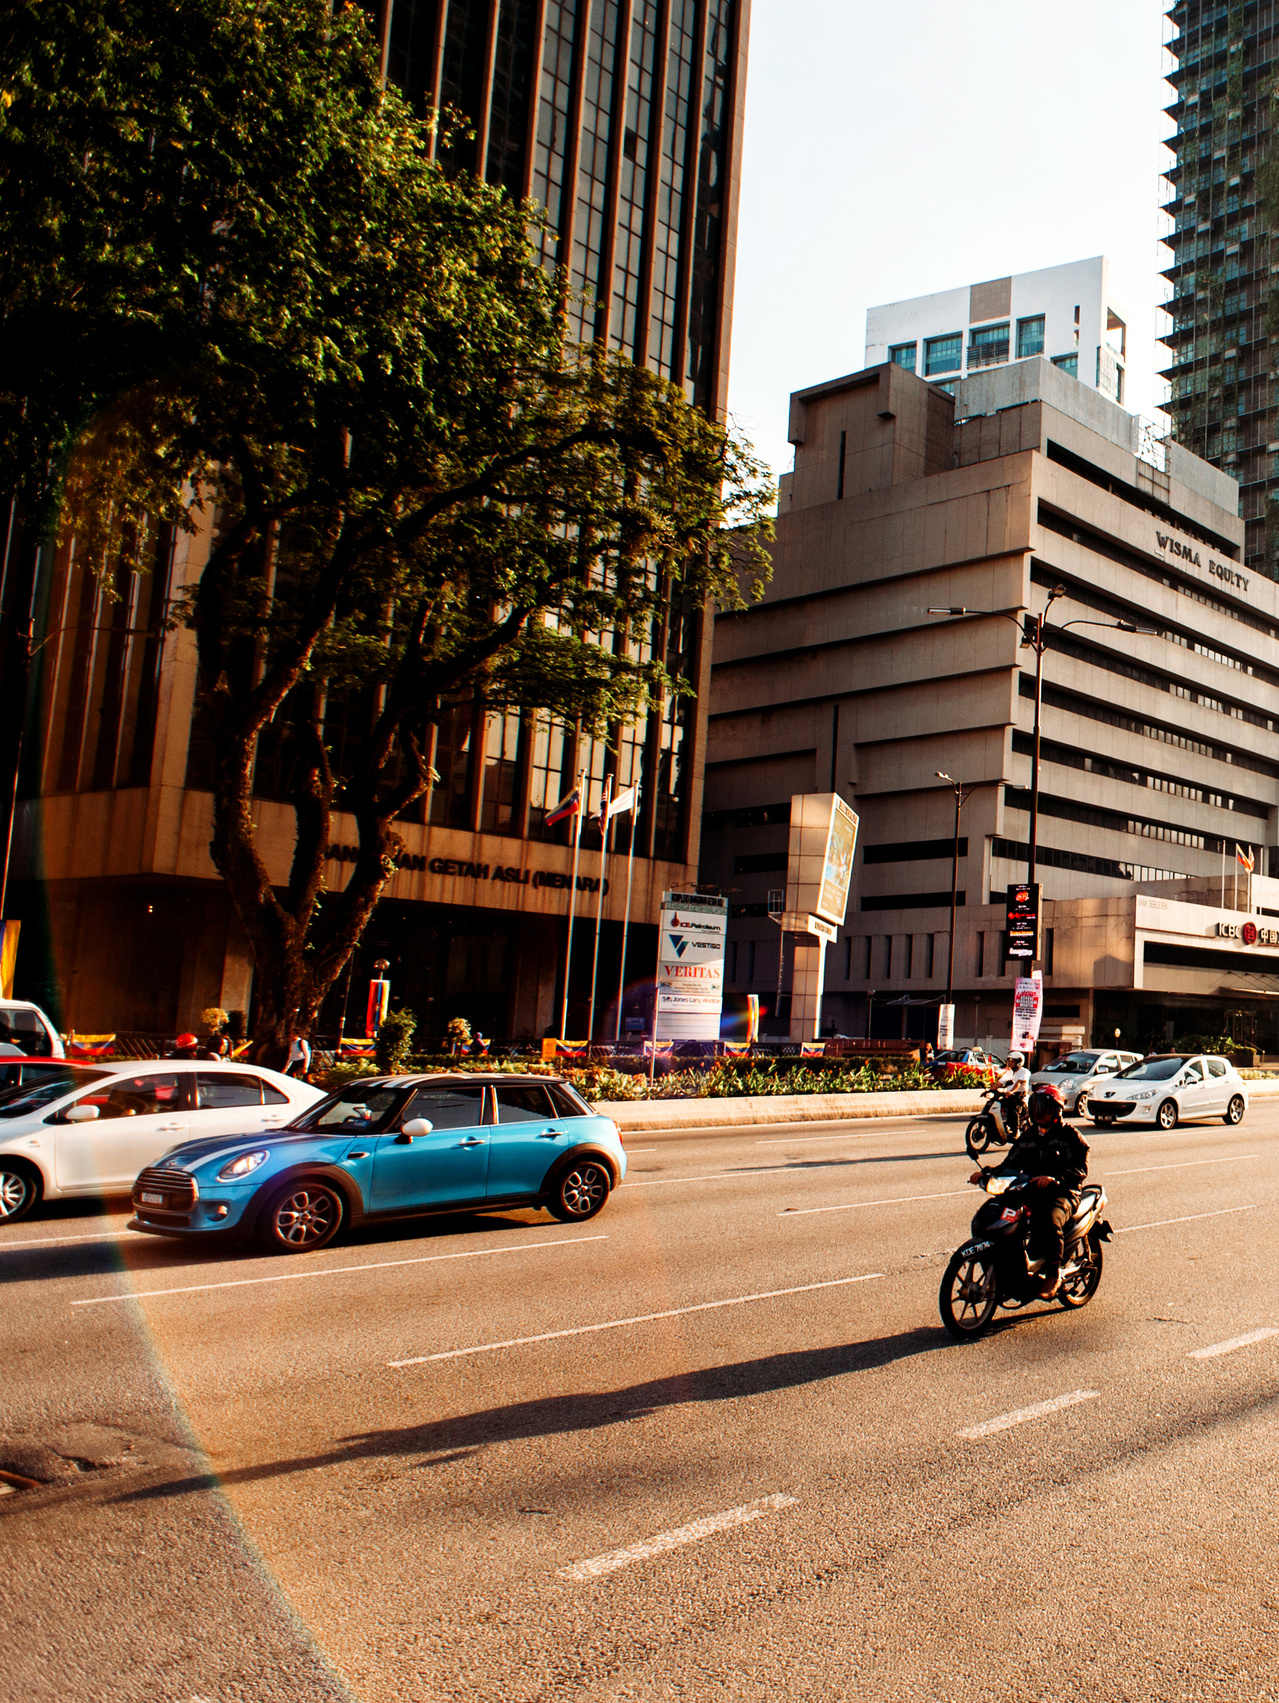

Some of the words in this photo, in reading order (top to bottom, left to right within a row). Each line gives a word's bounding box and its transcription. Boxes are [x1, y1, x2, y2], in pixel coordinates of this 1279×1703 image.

[1156, 531, 1201, 568] WISMA
[1208, 560, 1249, 591] EQUITY
[430, 857, 489, 880] GETAH
[491, 865, 530, 884] ASLI
[1216, 922, 1241, 938] ICBC
[664, 965, 720, 979] VERITAS
[1003, 1207, 1016, 1218] P
